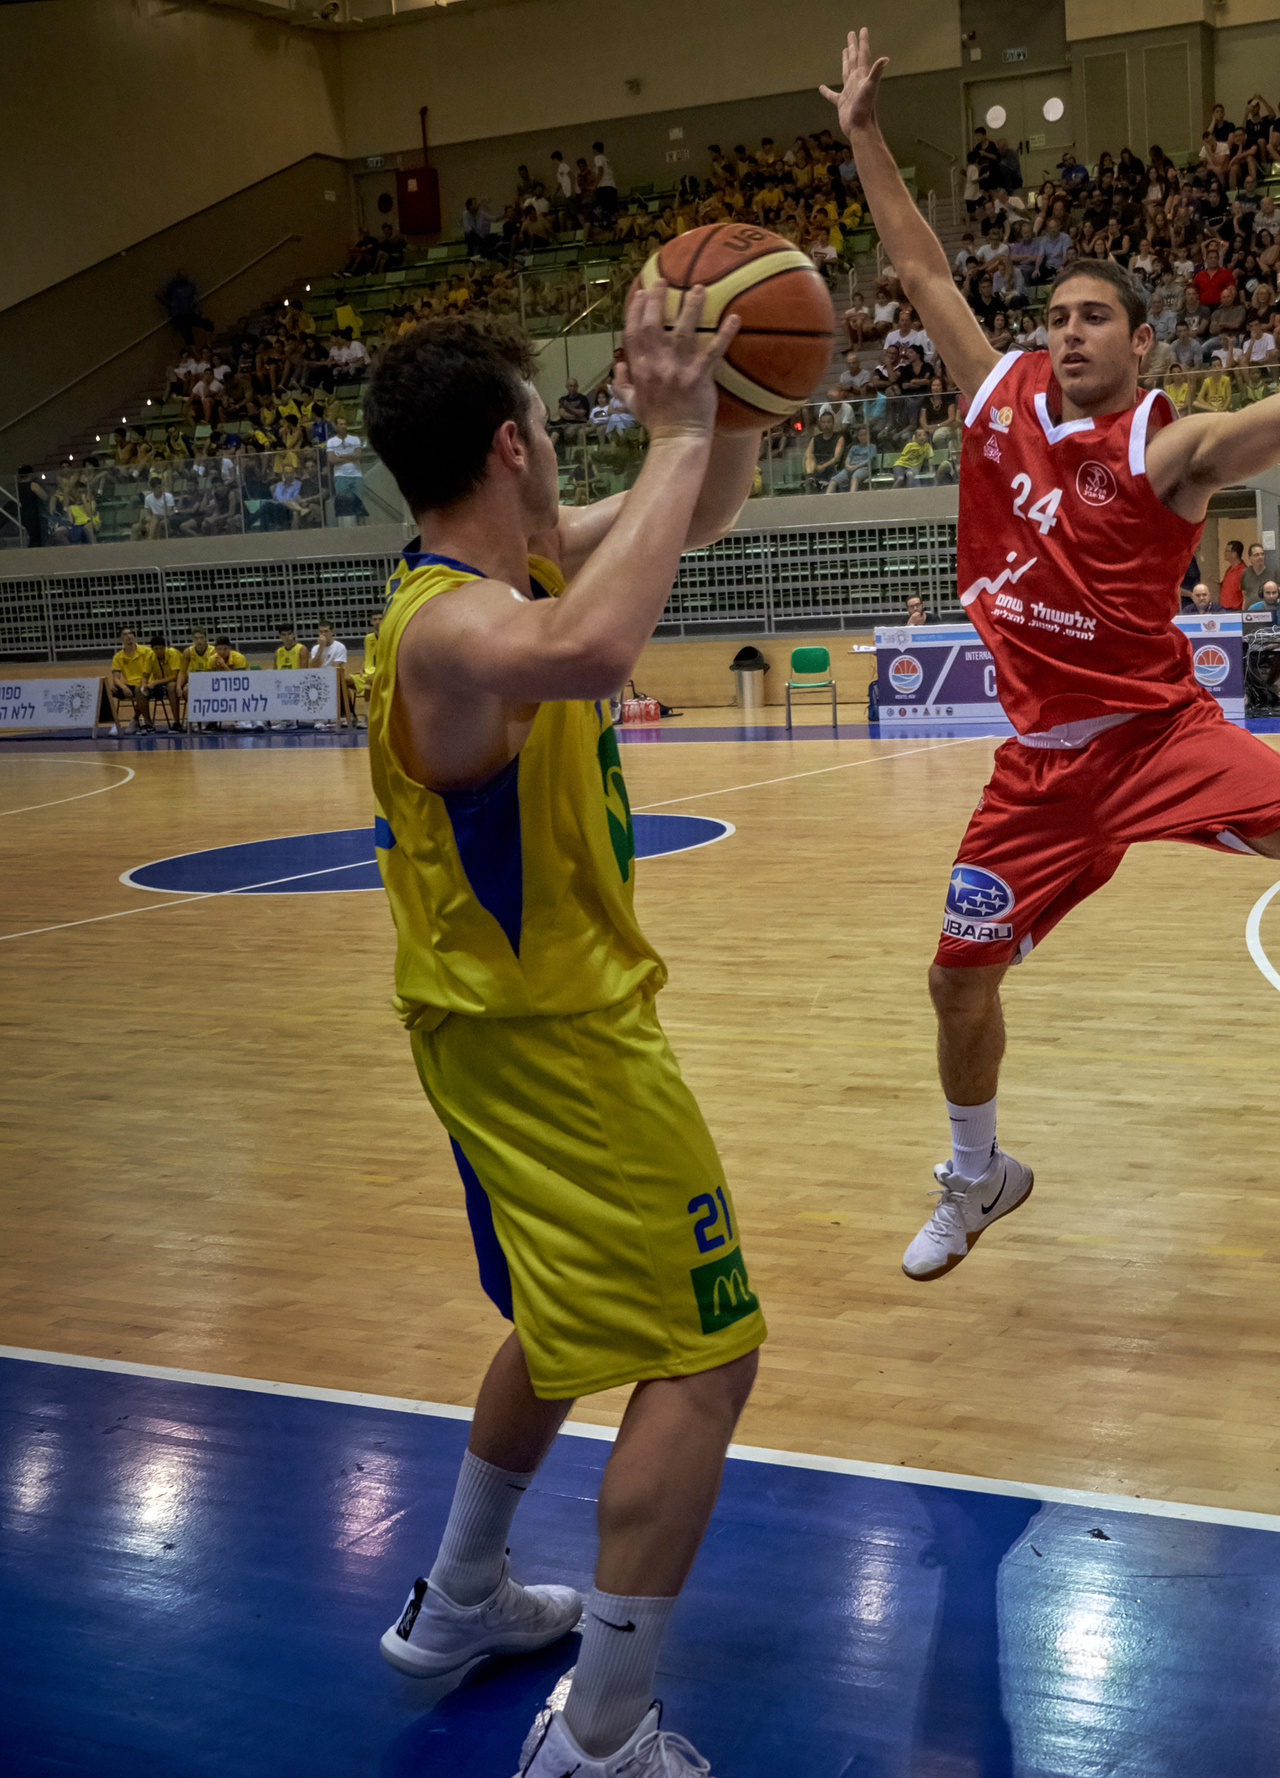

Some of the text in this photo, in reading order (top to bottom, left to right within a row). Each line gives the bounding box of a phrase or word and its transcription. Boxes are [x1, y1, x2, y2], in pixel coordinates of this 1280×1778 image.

[1011, 473, 1063, 535] 24
[995, 593, 1096, 630] אלטשולר שחם
[965, 651, 995, 661] INTERNA
[0, 686, 21, 700] ספו
[211, 676, 250, 692] ספורט
[11, 702, 35, 720] ללא
[193, 698, 236, 717] הפסקה
[242, 694, 268, 712] ללא
[942, 919, 1012, 940] UBARU
[687, 1186, 733, 1254] 21
